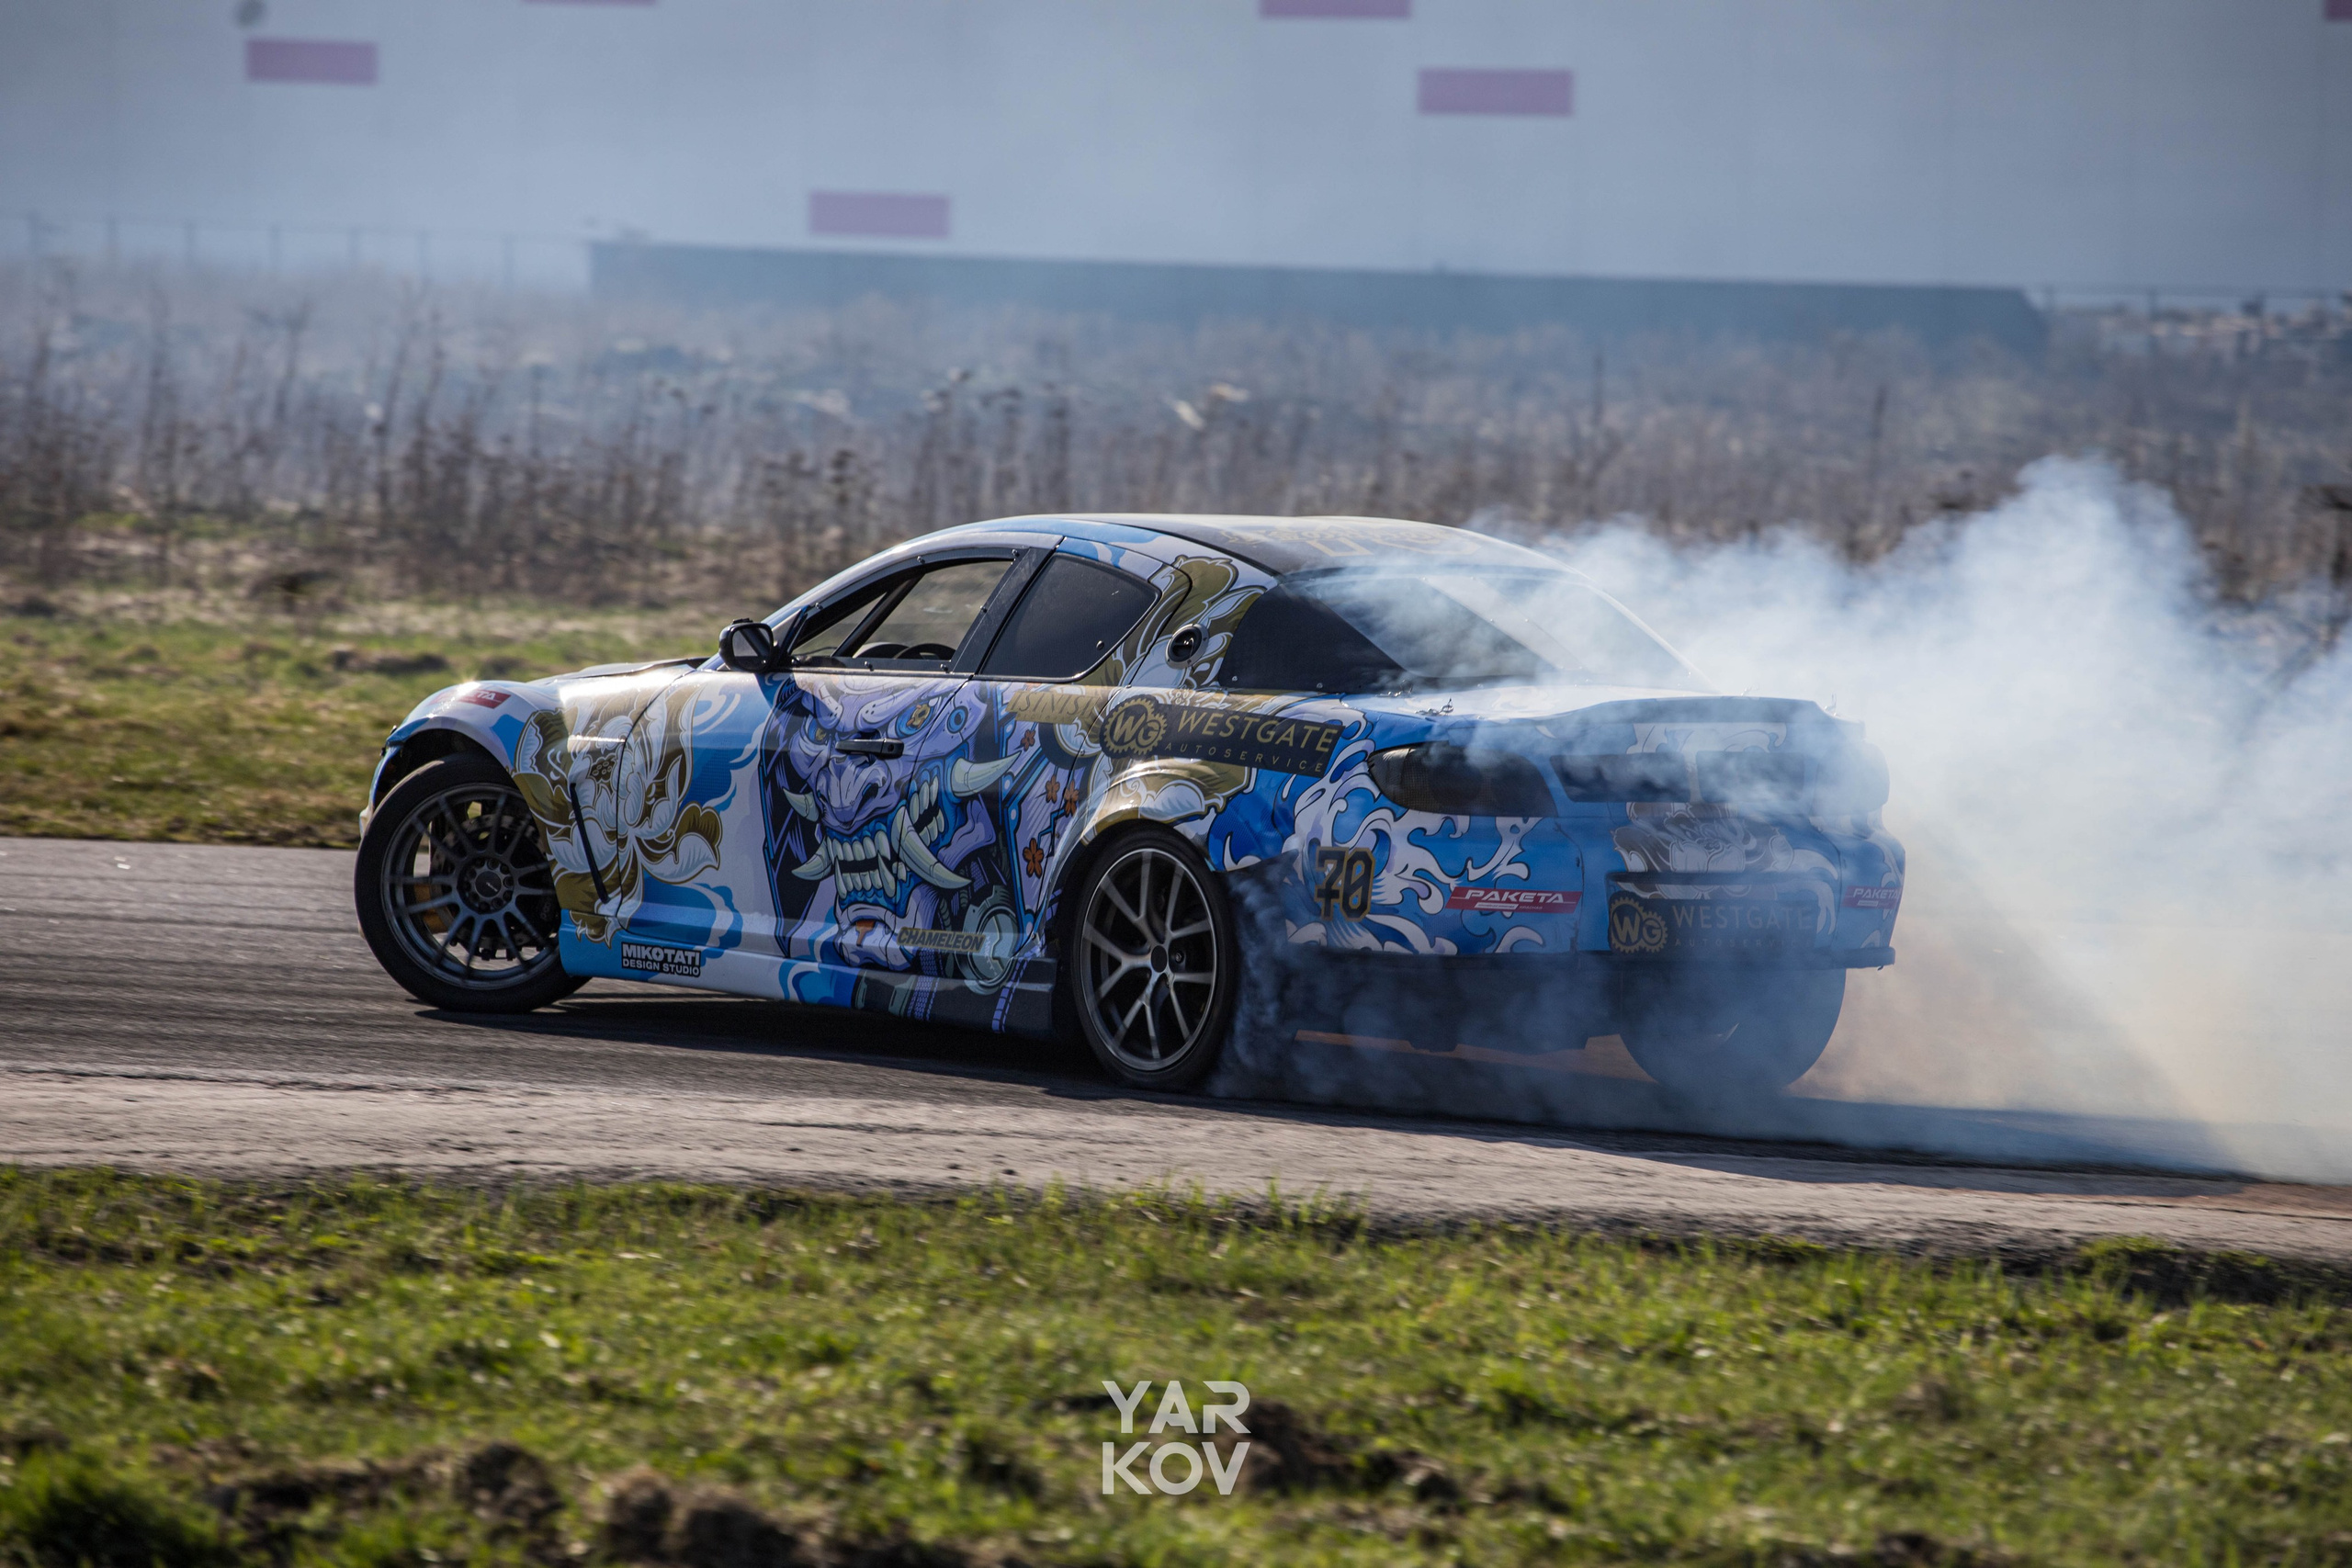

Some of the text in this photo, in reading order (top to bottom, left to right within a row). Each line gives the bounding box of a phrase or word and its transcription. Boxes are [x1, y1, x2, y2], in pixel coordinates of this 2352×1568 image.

[1113, 711, 1159, 743] WG
[1177, 710, 1339, 752] WESTGATE
[1165, 744, 1323, 773] AUTOSERVICE
[1315, 847, 1375, 921] 70
[1672, 905, 1813, 930] WESTGATE
[622, 943, 700, 965] MIKOTATI
[898, 929, 986, 952] CHAMELEON
[623, 958, 700, 976] DESIGN STUDIO
